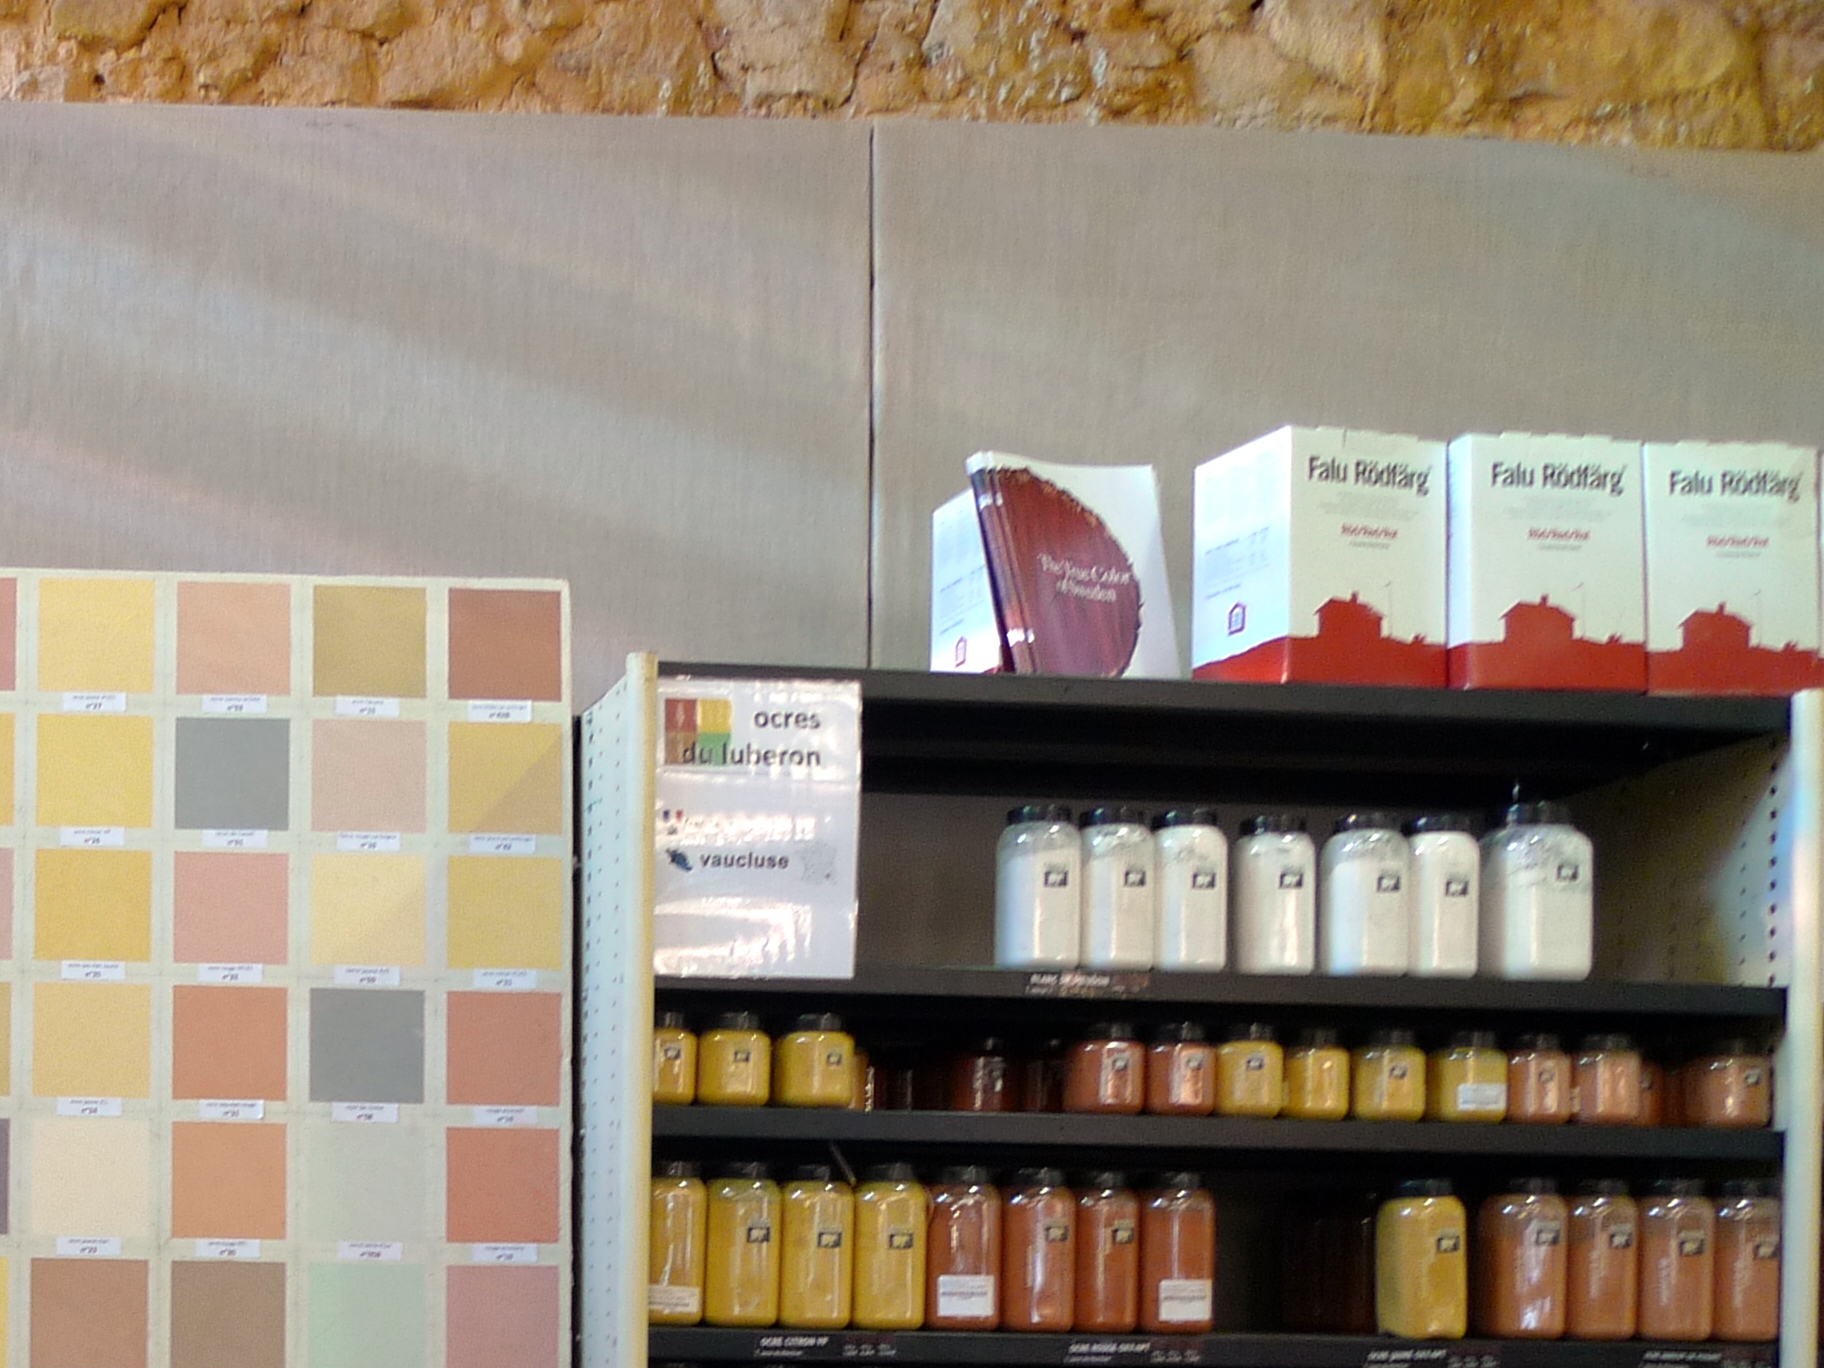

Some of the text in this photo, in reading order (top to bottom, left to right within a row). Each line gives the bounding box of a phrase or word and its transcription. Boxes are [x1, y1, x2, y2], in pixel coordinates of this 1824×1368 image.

[1308, 456, 1431, 496] Falu Rödfärg
[1491, 462, 1626, 497] Falu Rödfärg
[1669, 470, 1713, 495] Falu
[753, 708, 822, 730] ocres
[682, 743, 821, 768] du luberon
[699, 852, 790, 870] vaucluse
